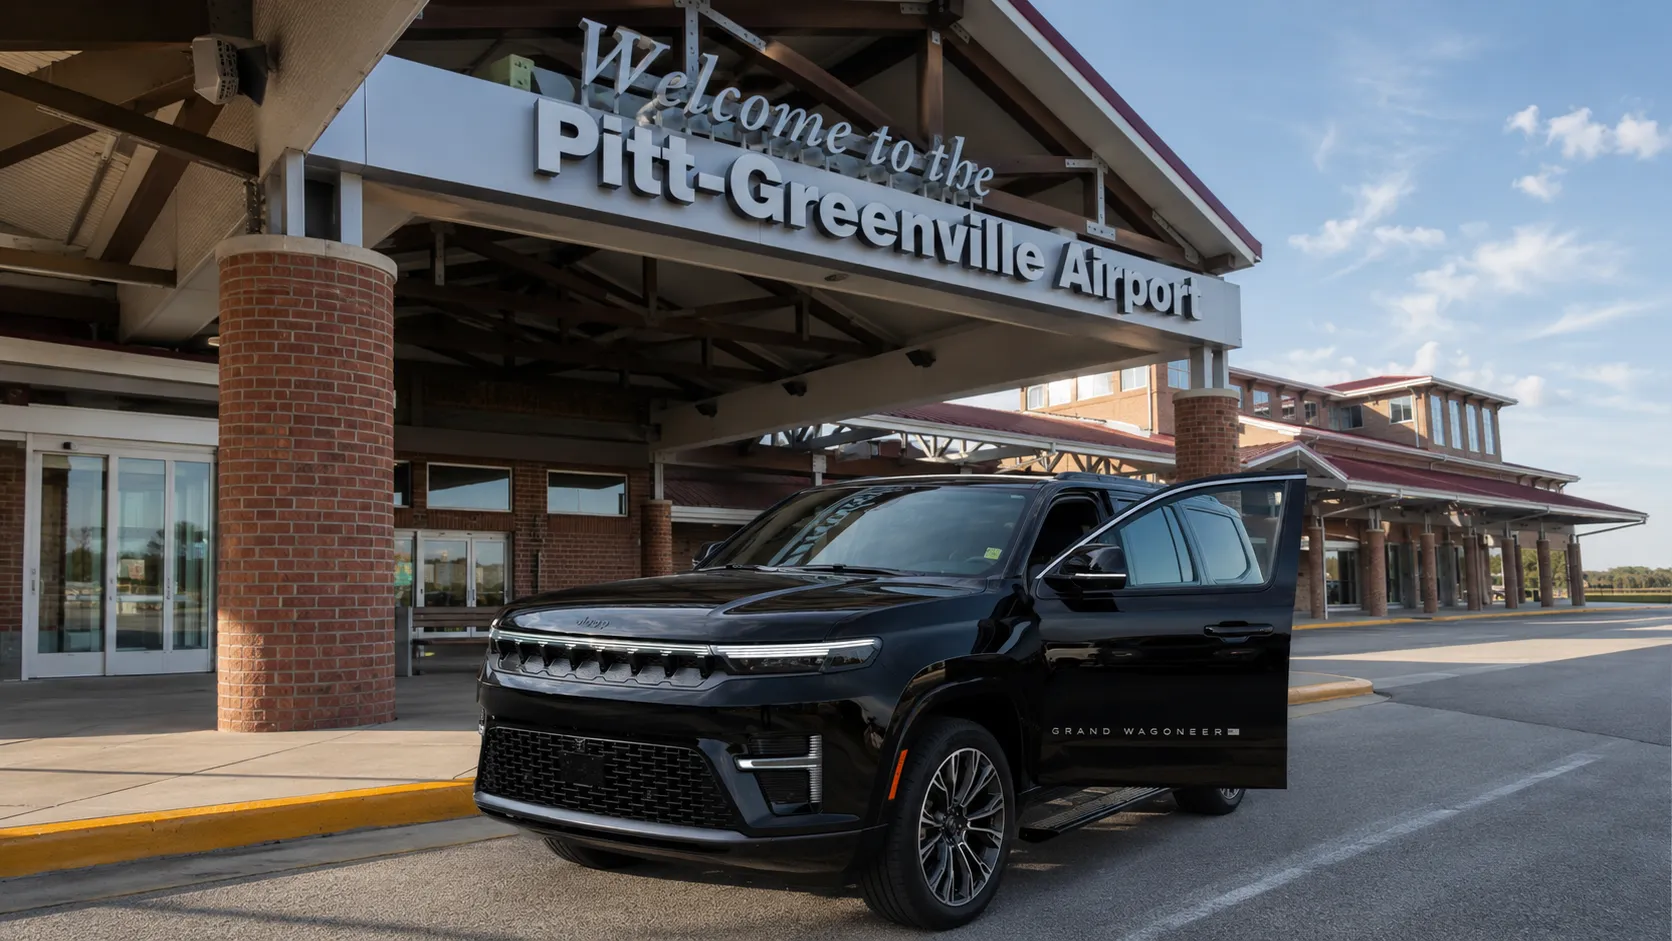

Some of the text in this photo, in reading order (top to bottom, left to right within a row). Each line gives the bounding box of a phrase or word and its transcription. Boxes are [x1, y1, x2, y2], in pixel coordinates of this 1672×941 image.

[579, 18, 995, 197] Welcome to the
[534, 98, 1203, 321] Pitt-Greenville Airport
[1051, 727, 1223, 736] GRAND WAGONEER
